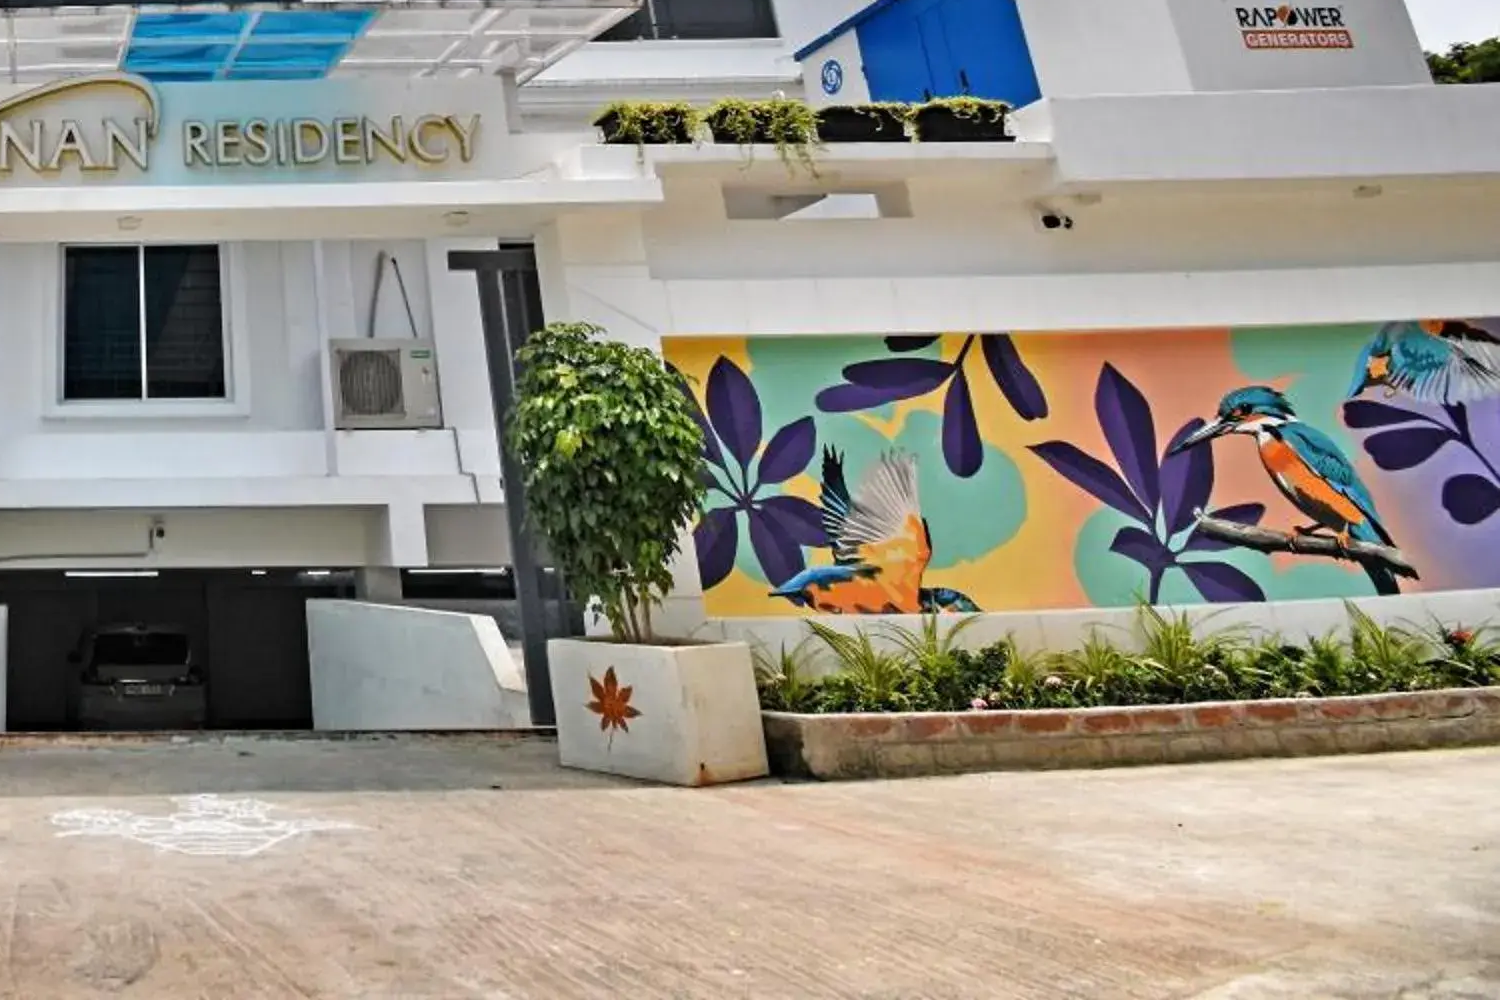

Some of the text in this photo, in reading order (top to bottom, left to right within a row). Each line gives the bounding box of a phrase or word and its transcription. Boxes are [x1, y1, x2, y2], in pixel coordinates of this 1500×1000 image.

[1235, 5, 1345, 27] RAPOWER
[1245, 32, 1350, 47] GENERATORS
[182, 104, 481, 166] RESIDENCY
